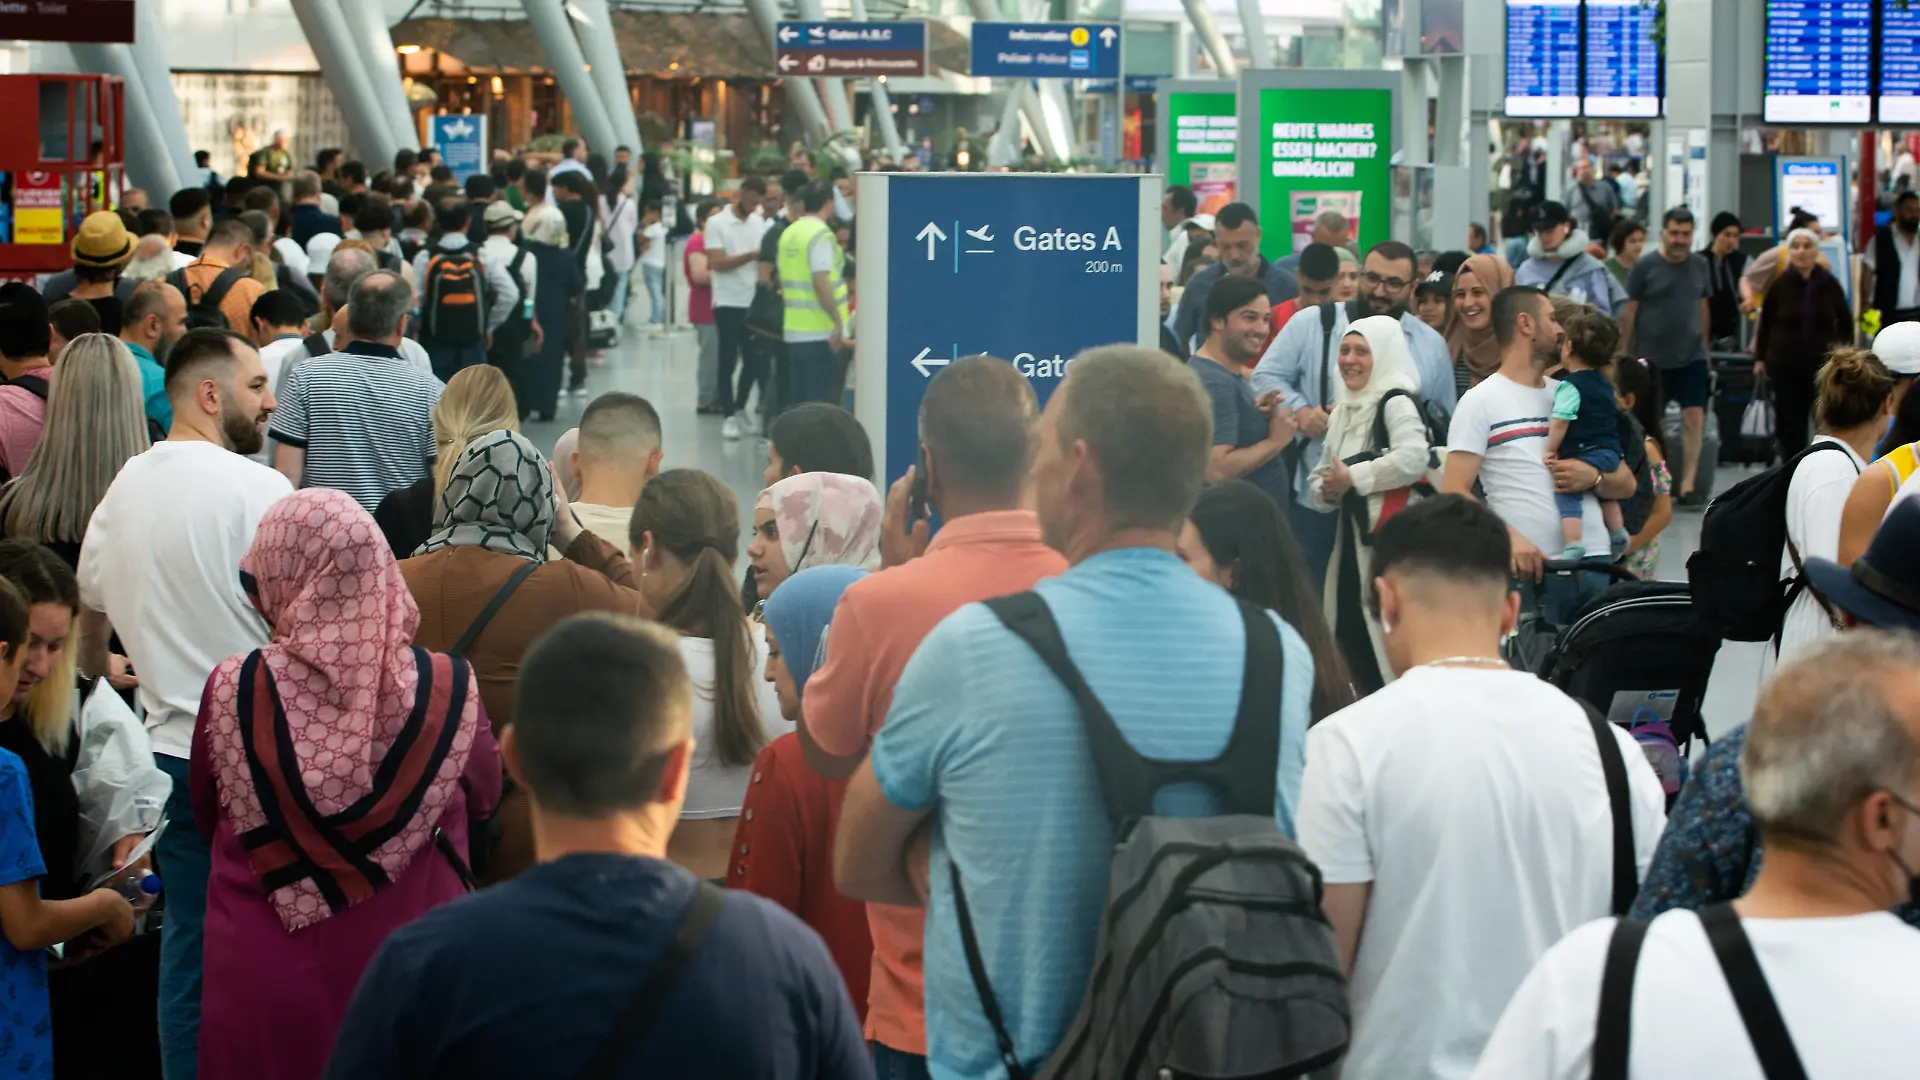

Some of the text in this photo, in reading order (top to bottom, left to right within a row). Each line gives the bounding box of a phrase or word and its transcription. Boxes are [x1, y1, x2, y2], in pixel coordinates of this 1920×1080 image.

[827, 28, 859, 41] Gates
[1008, 29, 1069, 41] Information
[1273, 123, 1375, 140] HEUTE WARMES
[1273, 142, 1377, 158] ESSEN MACHEN?
[1273, 158, 1355, 177] UNMÖGLICH!
[1013, 226, 1123, 251] Gates A
[1085, 261, 1123, 273] 200 m
